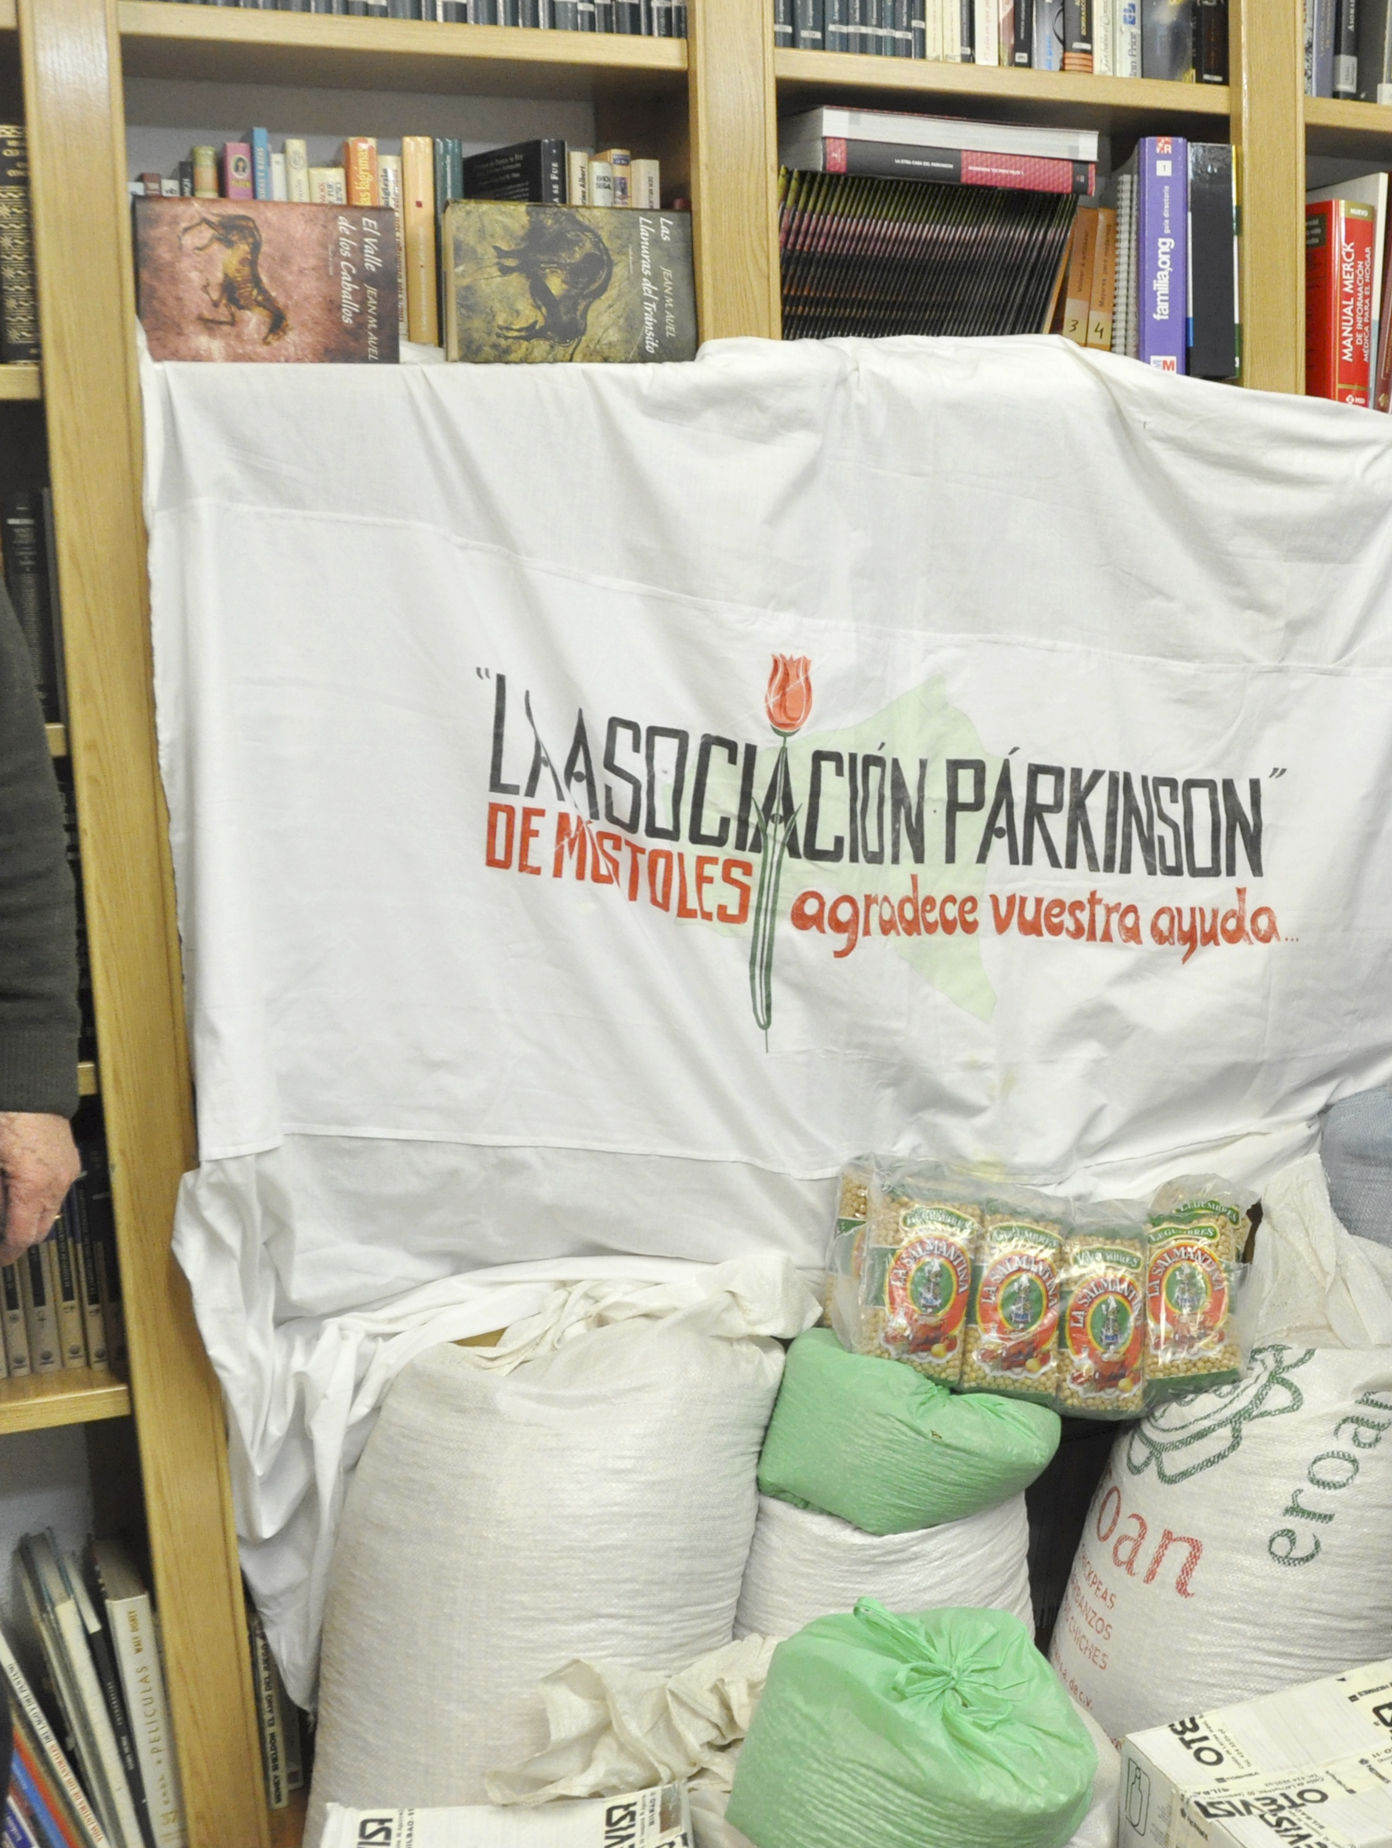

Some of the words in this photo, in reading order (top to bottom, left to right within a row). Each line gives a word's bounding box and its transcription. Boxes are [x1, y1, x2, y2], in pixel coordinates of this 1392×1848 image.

[1162, 185, 1171, 218] directorio
[1350, 208, 1369, 217] NUEVO
[337, 215, 355, 236] de
[362, 217, 377, 234] El
[660, 216, 673, 243] Las
[339, 237, 357, 257] los
[362, 237, 383, 273] Valle
[637, 216, 656, 276] Llanuras
[659, 265, 674, 296] JEAN
[1342, 241, 1355, 293] MERCK
[339, 259, 361, 326] Caballos
[362, 283, 379, 309] JEAN
[641, 276, 658, 298] del
[1356, 260, 1364, 329] INFORMACIÓN
[1365, 285, 1371, 296] EL
[642, 297, 662, 354] Tránsito
[664, 310, 677, 339] AUEL
[1068, 319, 1080, 333] 3
[1094, 322, 1105, 340] 4
[1342, 297, 1355, 363] MANUAL
[1356, 332, 1364, 346] DE
[365, 331, 380, 362] AUEL
[485, 801, 547, 877] DE
[552, 811, 754, 925] MSTOLES
[789, 873, 981, 960] agradece
[988, 888, 1144, 947] vuestra
[890, 1266, 909, 1288] LA
[903, 1237, 970, 1294] SALMANTINA
[1153, 1246, 1226, 1292] SALMANTINA
[981, 1284, 998, 1306] LA
[990, 1254, 1060, 1309] SALMANTINA
[1149, 1278, 1162, 1299] LA
[1070, 1309, 1086, 1328] LA
[261, 1644, 271, 1671] JUEGO
[263, 1675, 272, 1692] DEL
[135, 1665, 163, 1756] PELICULAS
[267, 1717, 276, 1728] EL
[48, 1743, 71, 1779] ANIMALES
[268, 1731, 281, 1773] SHELDON
